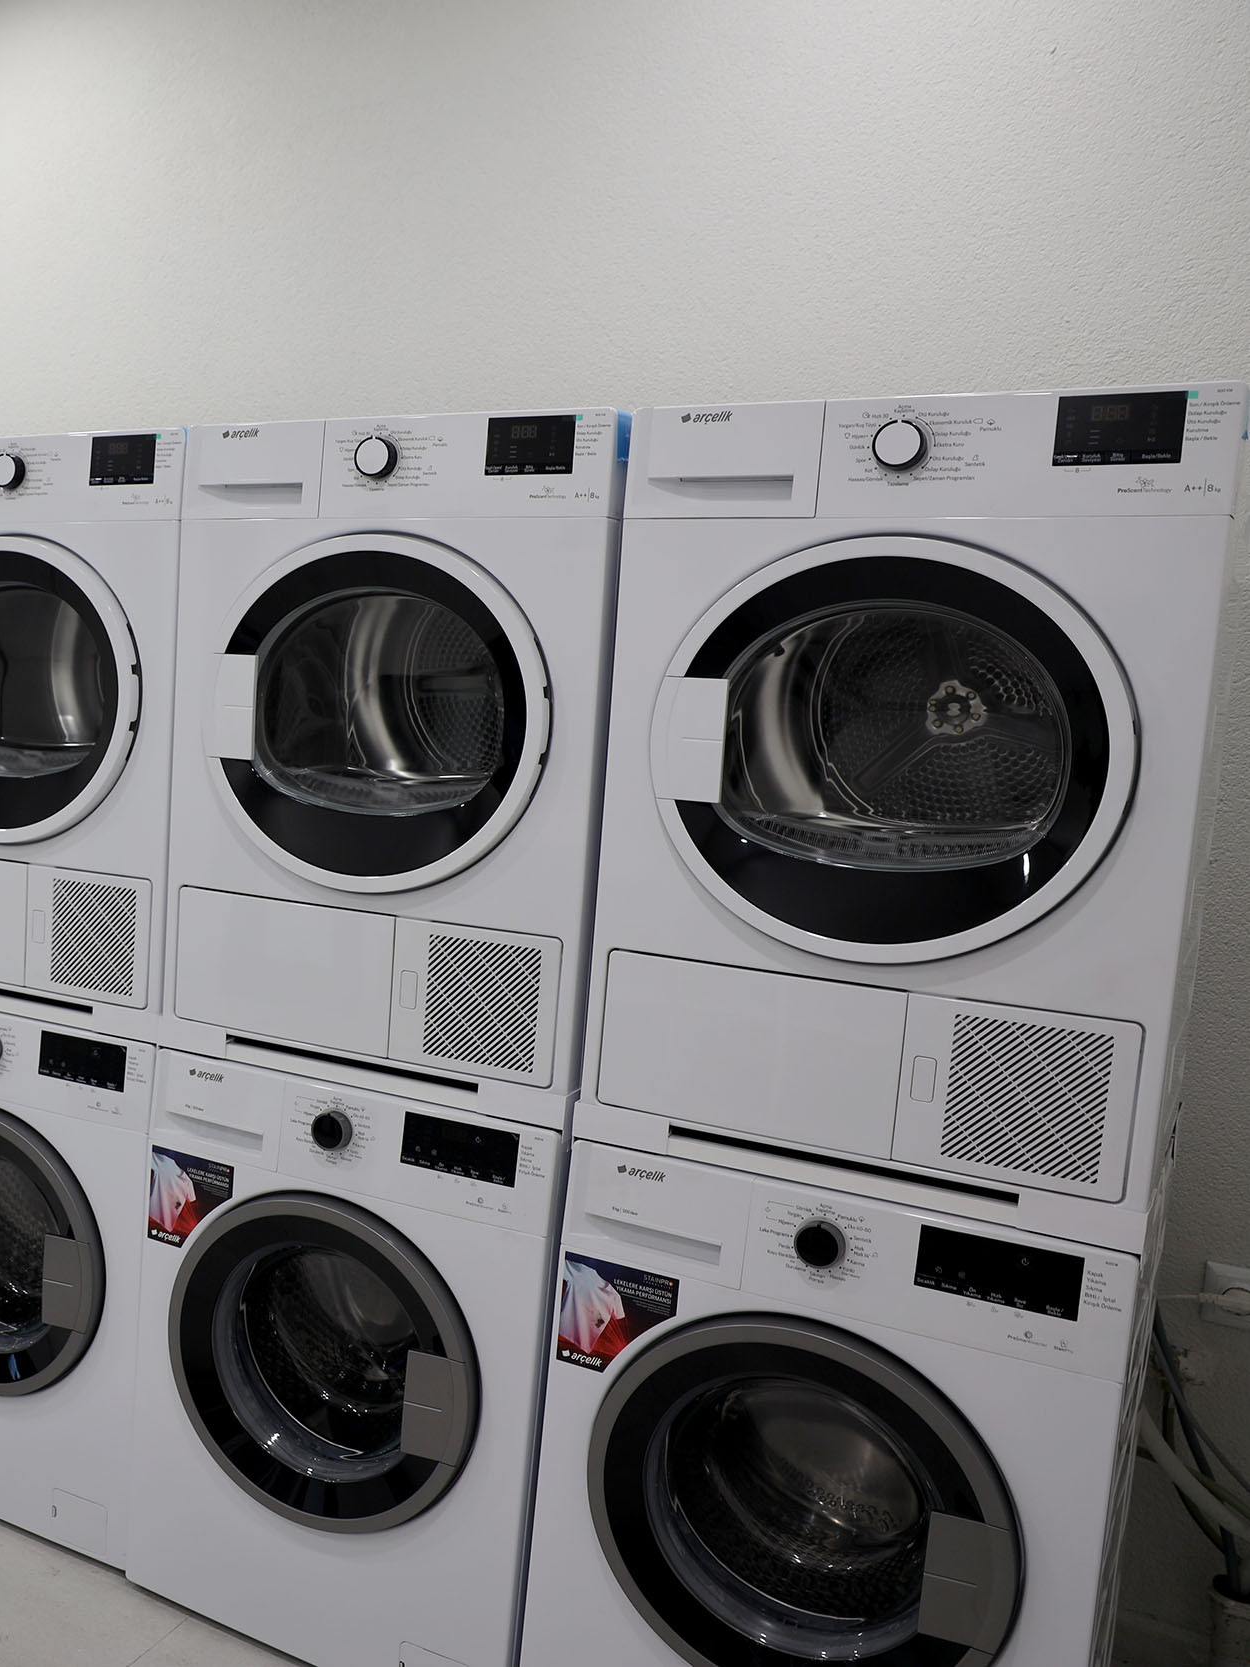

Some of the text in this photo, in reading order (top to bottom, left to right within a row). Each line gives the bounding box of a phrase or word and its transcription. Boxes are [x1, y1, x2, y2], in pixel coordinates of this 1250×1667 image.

[693, 411, 733, 424] arçelik
[230, 427, 260, 440] arçelik
[196, 1070, 225, 1083] arçelik
[628, 1166, 667, 1183] arçelik
[157, 1231, 181, 1243] arçelik
[613, 1278, 638, 1290] LEKELERE
[615, 1285, 636, 1296] YIKAMA
[635, 1290, 672, 1305] PERFORMANSI
[571, 1352, 603, 1368] arçelik
